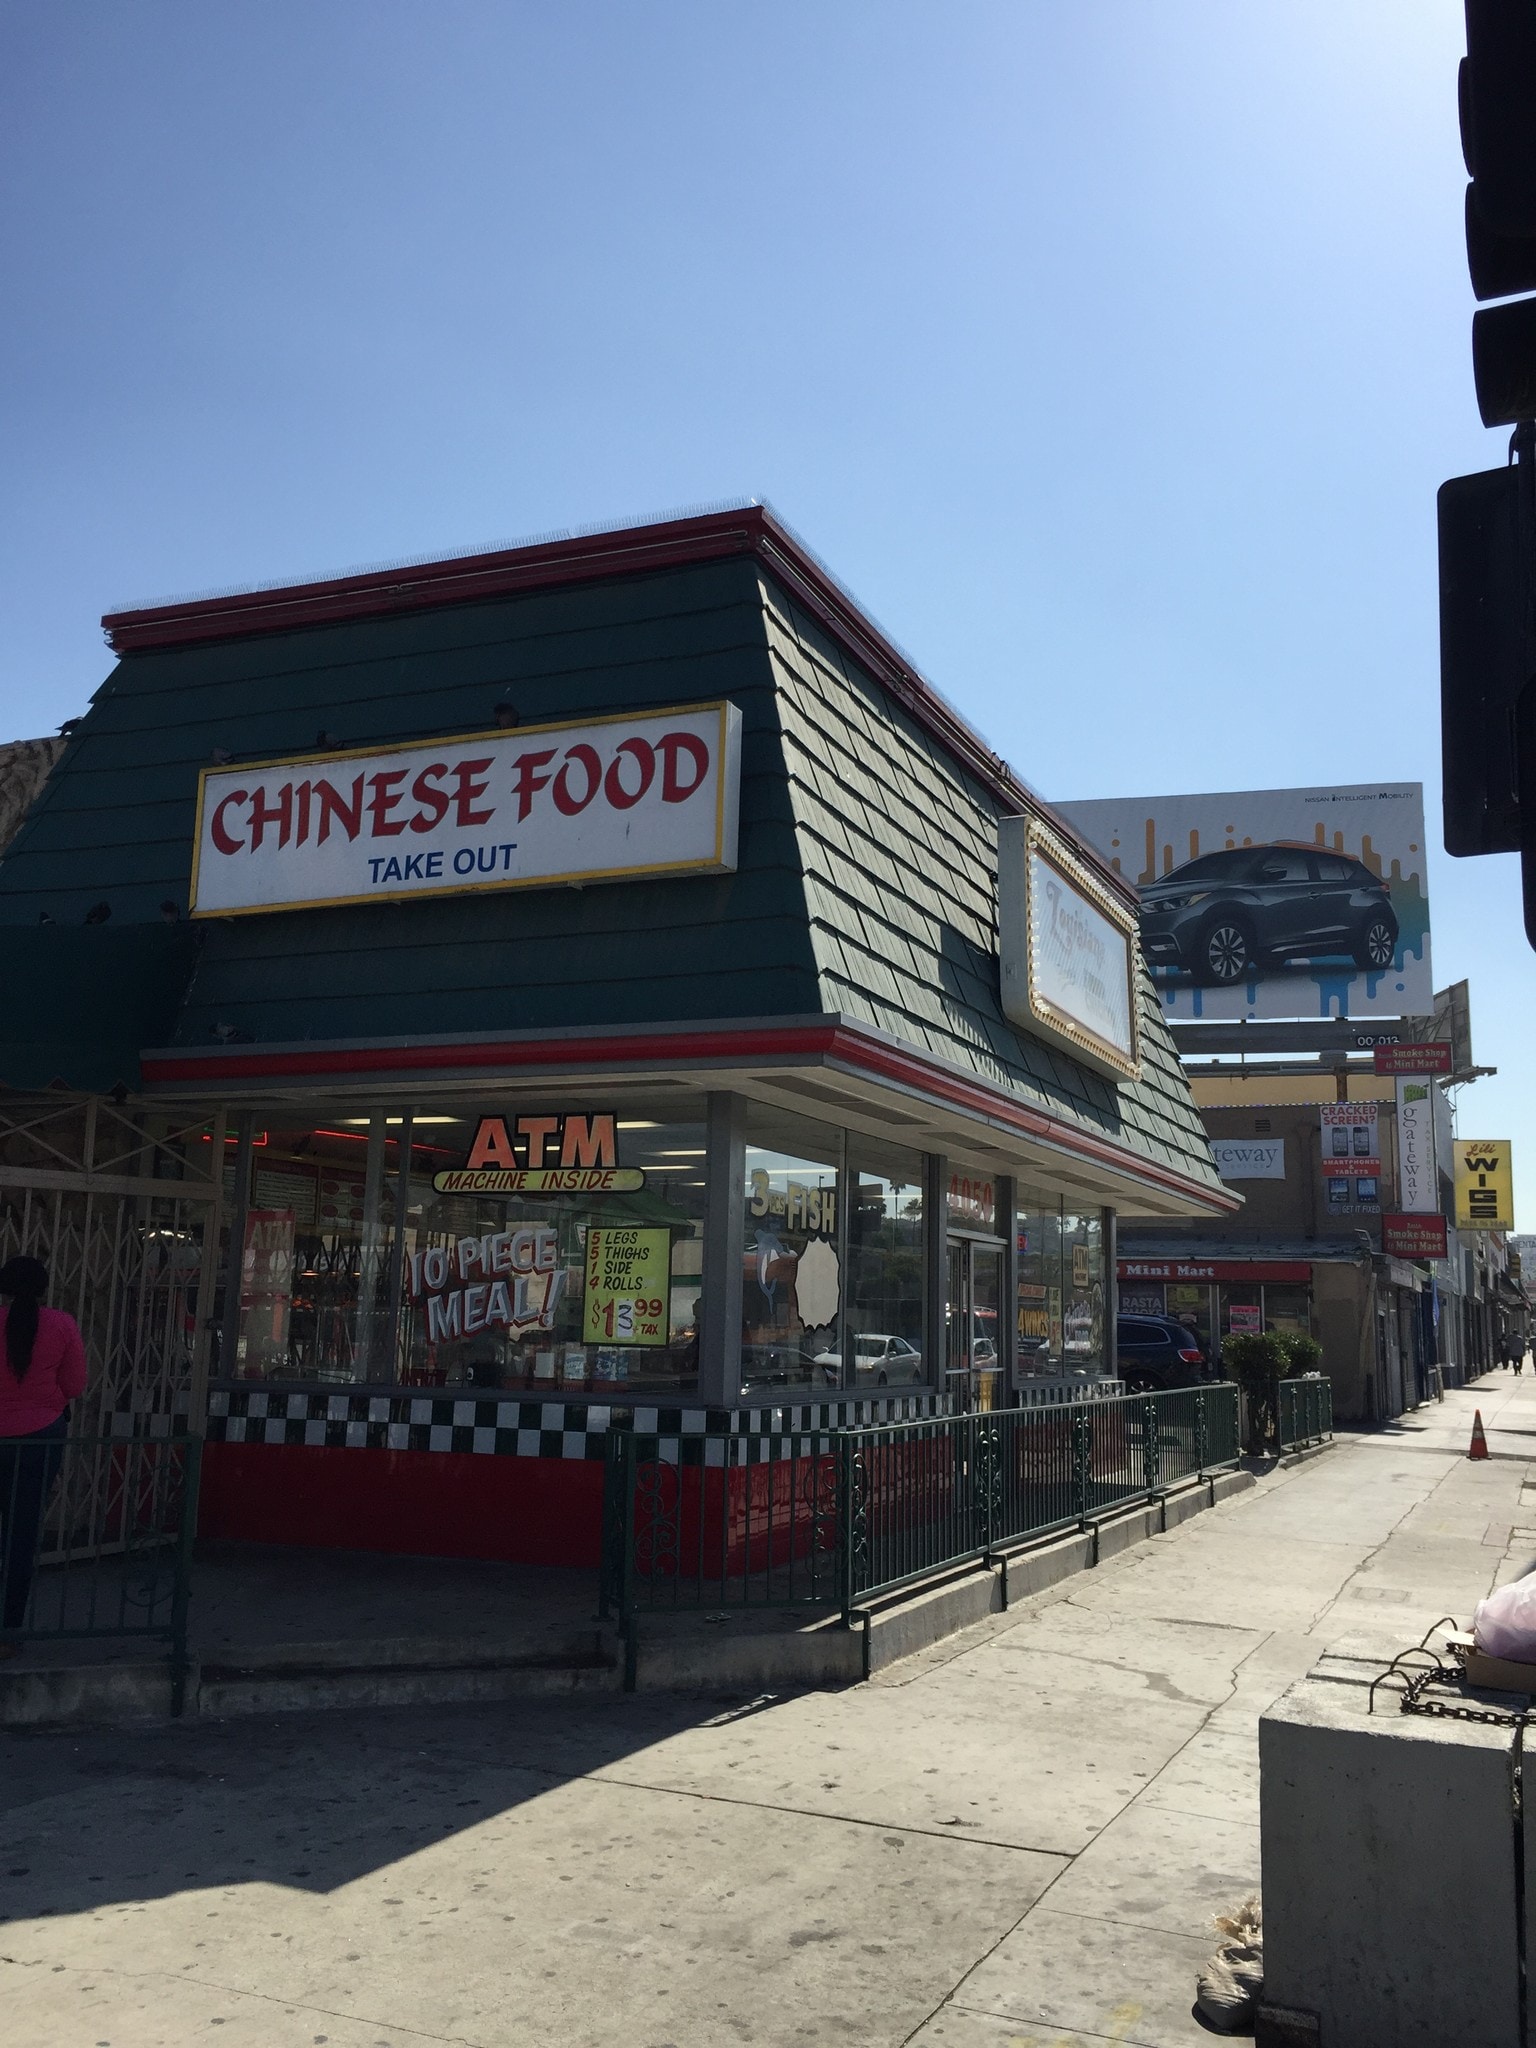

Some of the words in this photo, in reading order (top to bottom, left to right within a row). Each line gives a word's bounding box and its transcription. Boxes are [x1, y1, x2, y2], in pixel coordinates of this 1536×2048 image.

[211, 757, 498, 856] CHINESE
[511, 732, 710, 824] FOOD
[1331, 794, 1377, 802] INTELLIGENT
[1378, 792, 1414, 800] MOBILITY
[368, 851, 444, 884] TAKE
[453, 843, 518, 875] OUT
[1393, 1049, 1425, 1059] Smoke
[1425, 1048, 1447, 1059] Shop
[1394, 1060, 1415, 1069] Mini
[1417, 1060, 1440, 1069] Mart
[1321, 1106, 1377, 1116] CRACKED
[1323, 1115, 1375, 1125] SCREEN?
[466, 1114, 618, 1169] ATM
[1403, 1107, 1420, 1205] gateway
[1466, 1143, 1496, 1156] Lili
[442, 1171, 527, 1190] MACHINE
[540, 1170, 617, 1189] INSIDE
[1464, 1158, 1499, 1218] WIGS
[751, 1168, 770, 1217] 3
[770, 1196, 785, 1214] PCS
[787, 1180, 836, 1233] FISH
[1362, 1205, 1381, 1213] FIXED
[250, 1221, 292, 1249] ATM
[591, 1232, 601, 1245] 5
[605, 1232, 638, 1245] LEGS
[1387, 1229, 1419, 1239] Smoke
[1420, 1231, 1442, 1241] Shop
[1396, 1241, 1417, 1251] Mini
[1419, 1241, 1441, 1251] Mart
[589, 1247, 600, 1260] 5
[604, 1247, 650, 1261] THIGHS
[409, 1247, 449, 1297] 10
[458, 1228, 558, 1280] PIECE
[590, 1262, 598, 1275] 1
[604, 1261, 633, 1275] SIDE
[1126, 1265, 1171, 1276] Mini
[1177, 1265, 1215, 1277] Mart
[589, 1276, 600, 1290] 4
[427, 1270, 568, 1343] MEAL!
[1122, 1298, 1162, 1309] RASTA
[640, 1324, 659, 1335] TAX
